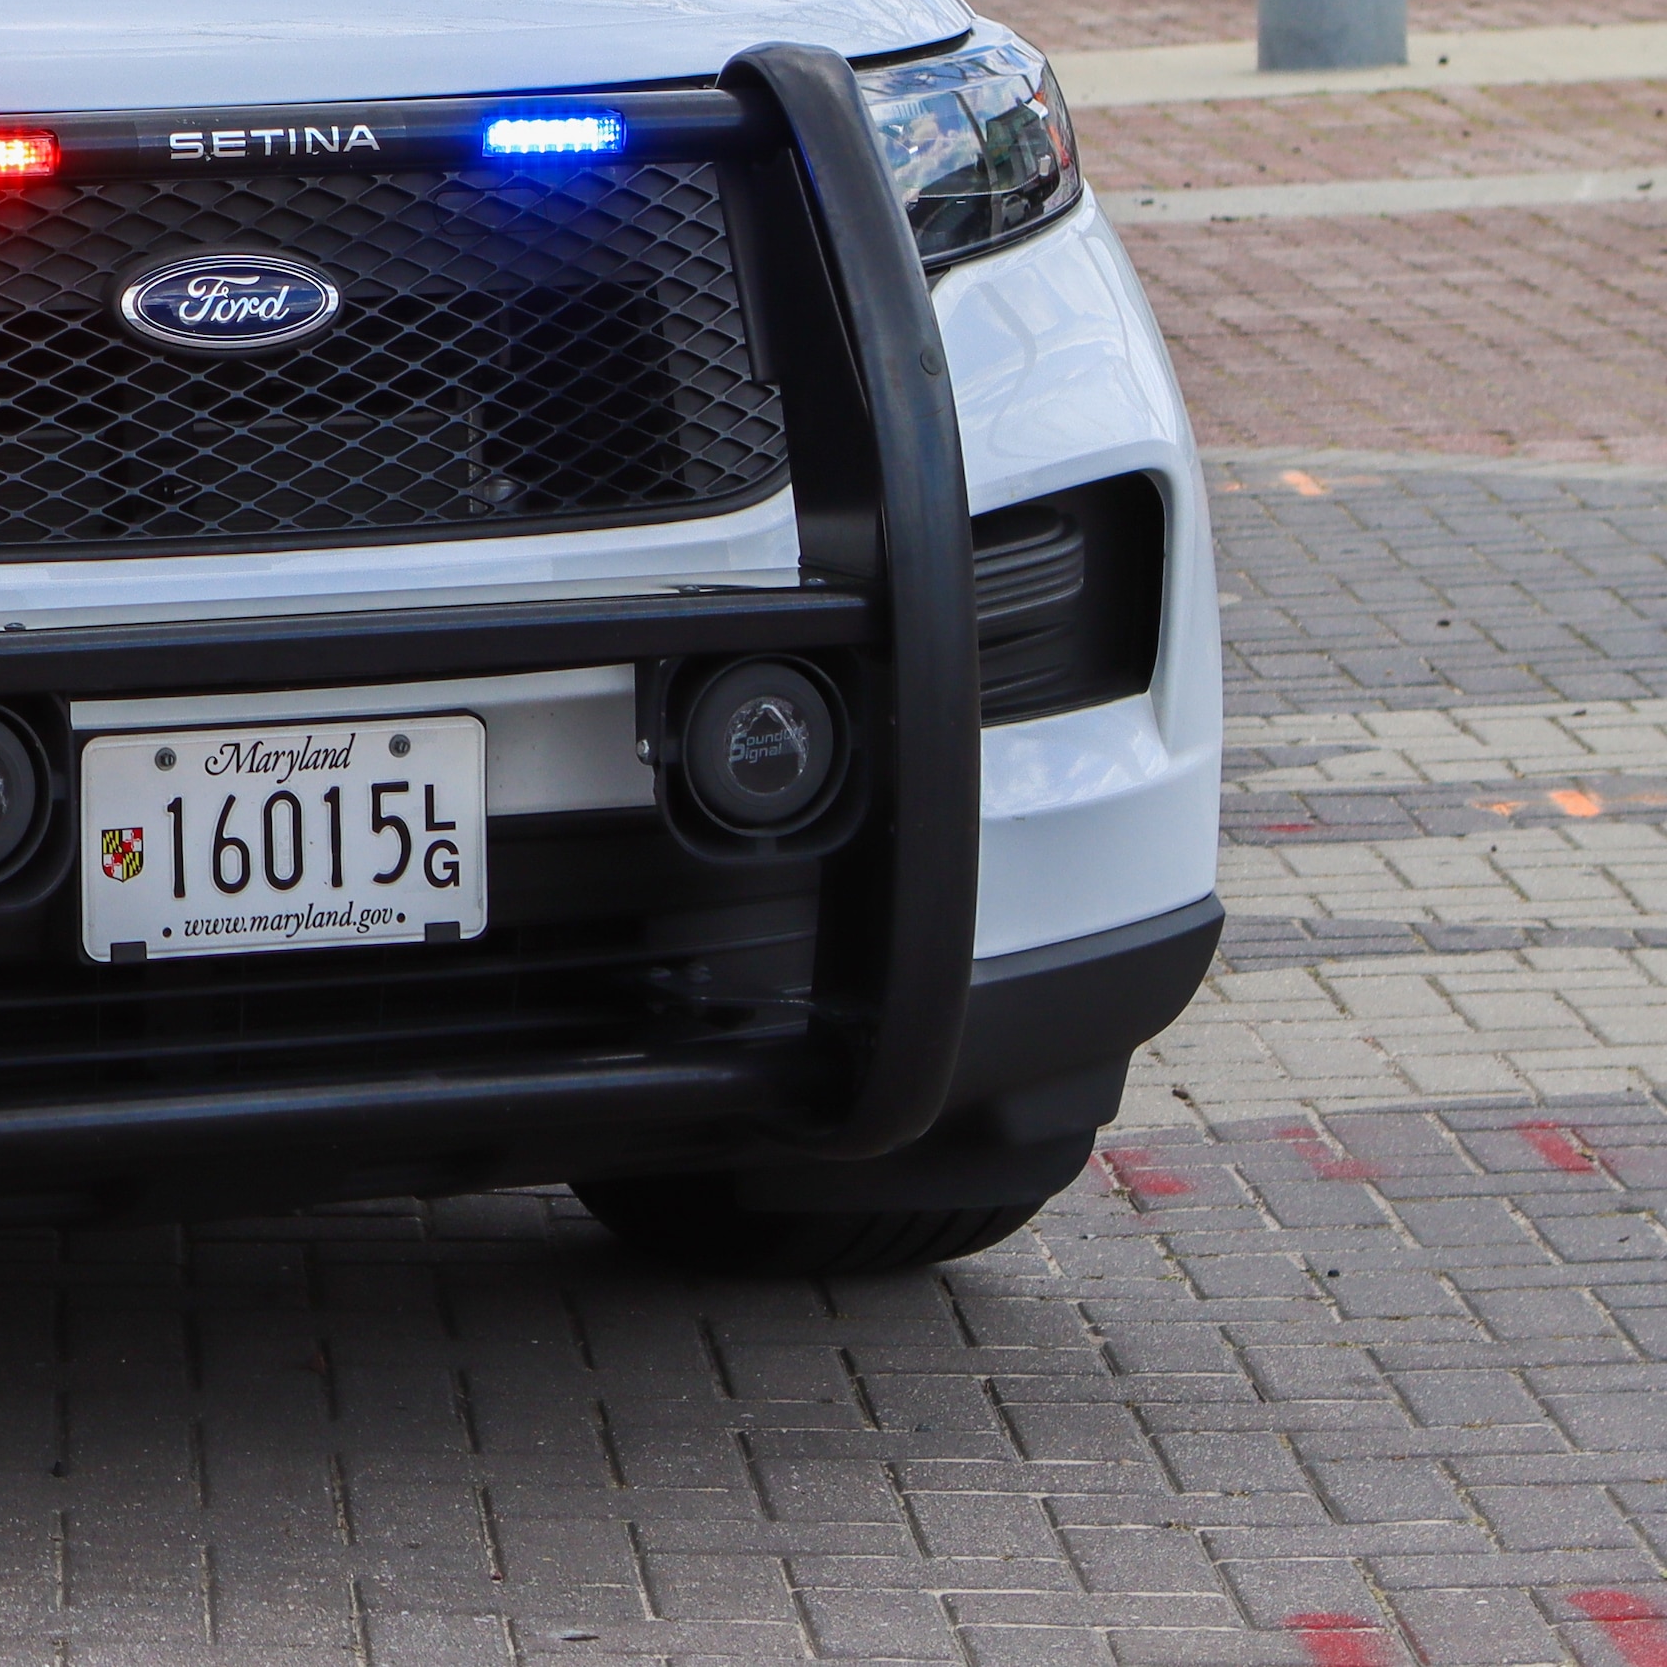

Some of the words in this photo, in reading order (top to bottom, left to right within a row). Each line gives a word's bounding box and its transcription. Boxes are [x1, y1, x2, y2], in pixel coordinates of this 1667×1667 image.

[169, 124, 381, 160] SETINA
[178, 275, 291, 325] Ford
[204, 733, 357, 784] Maryland
[166, 780, 412, 899] 16015
[184, 901, 395, 938] www.maryland.gov
